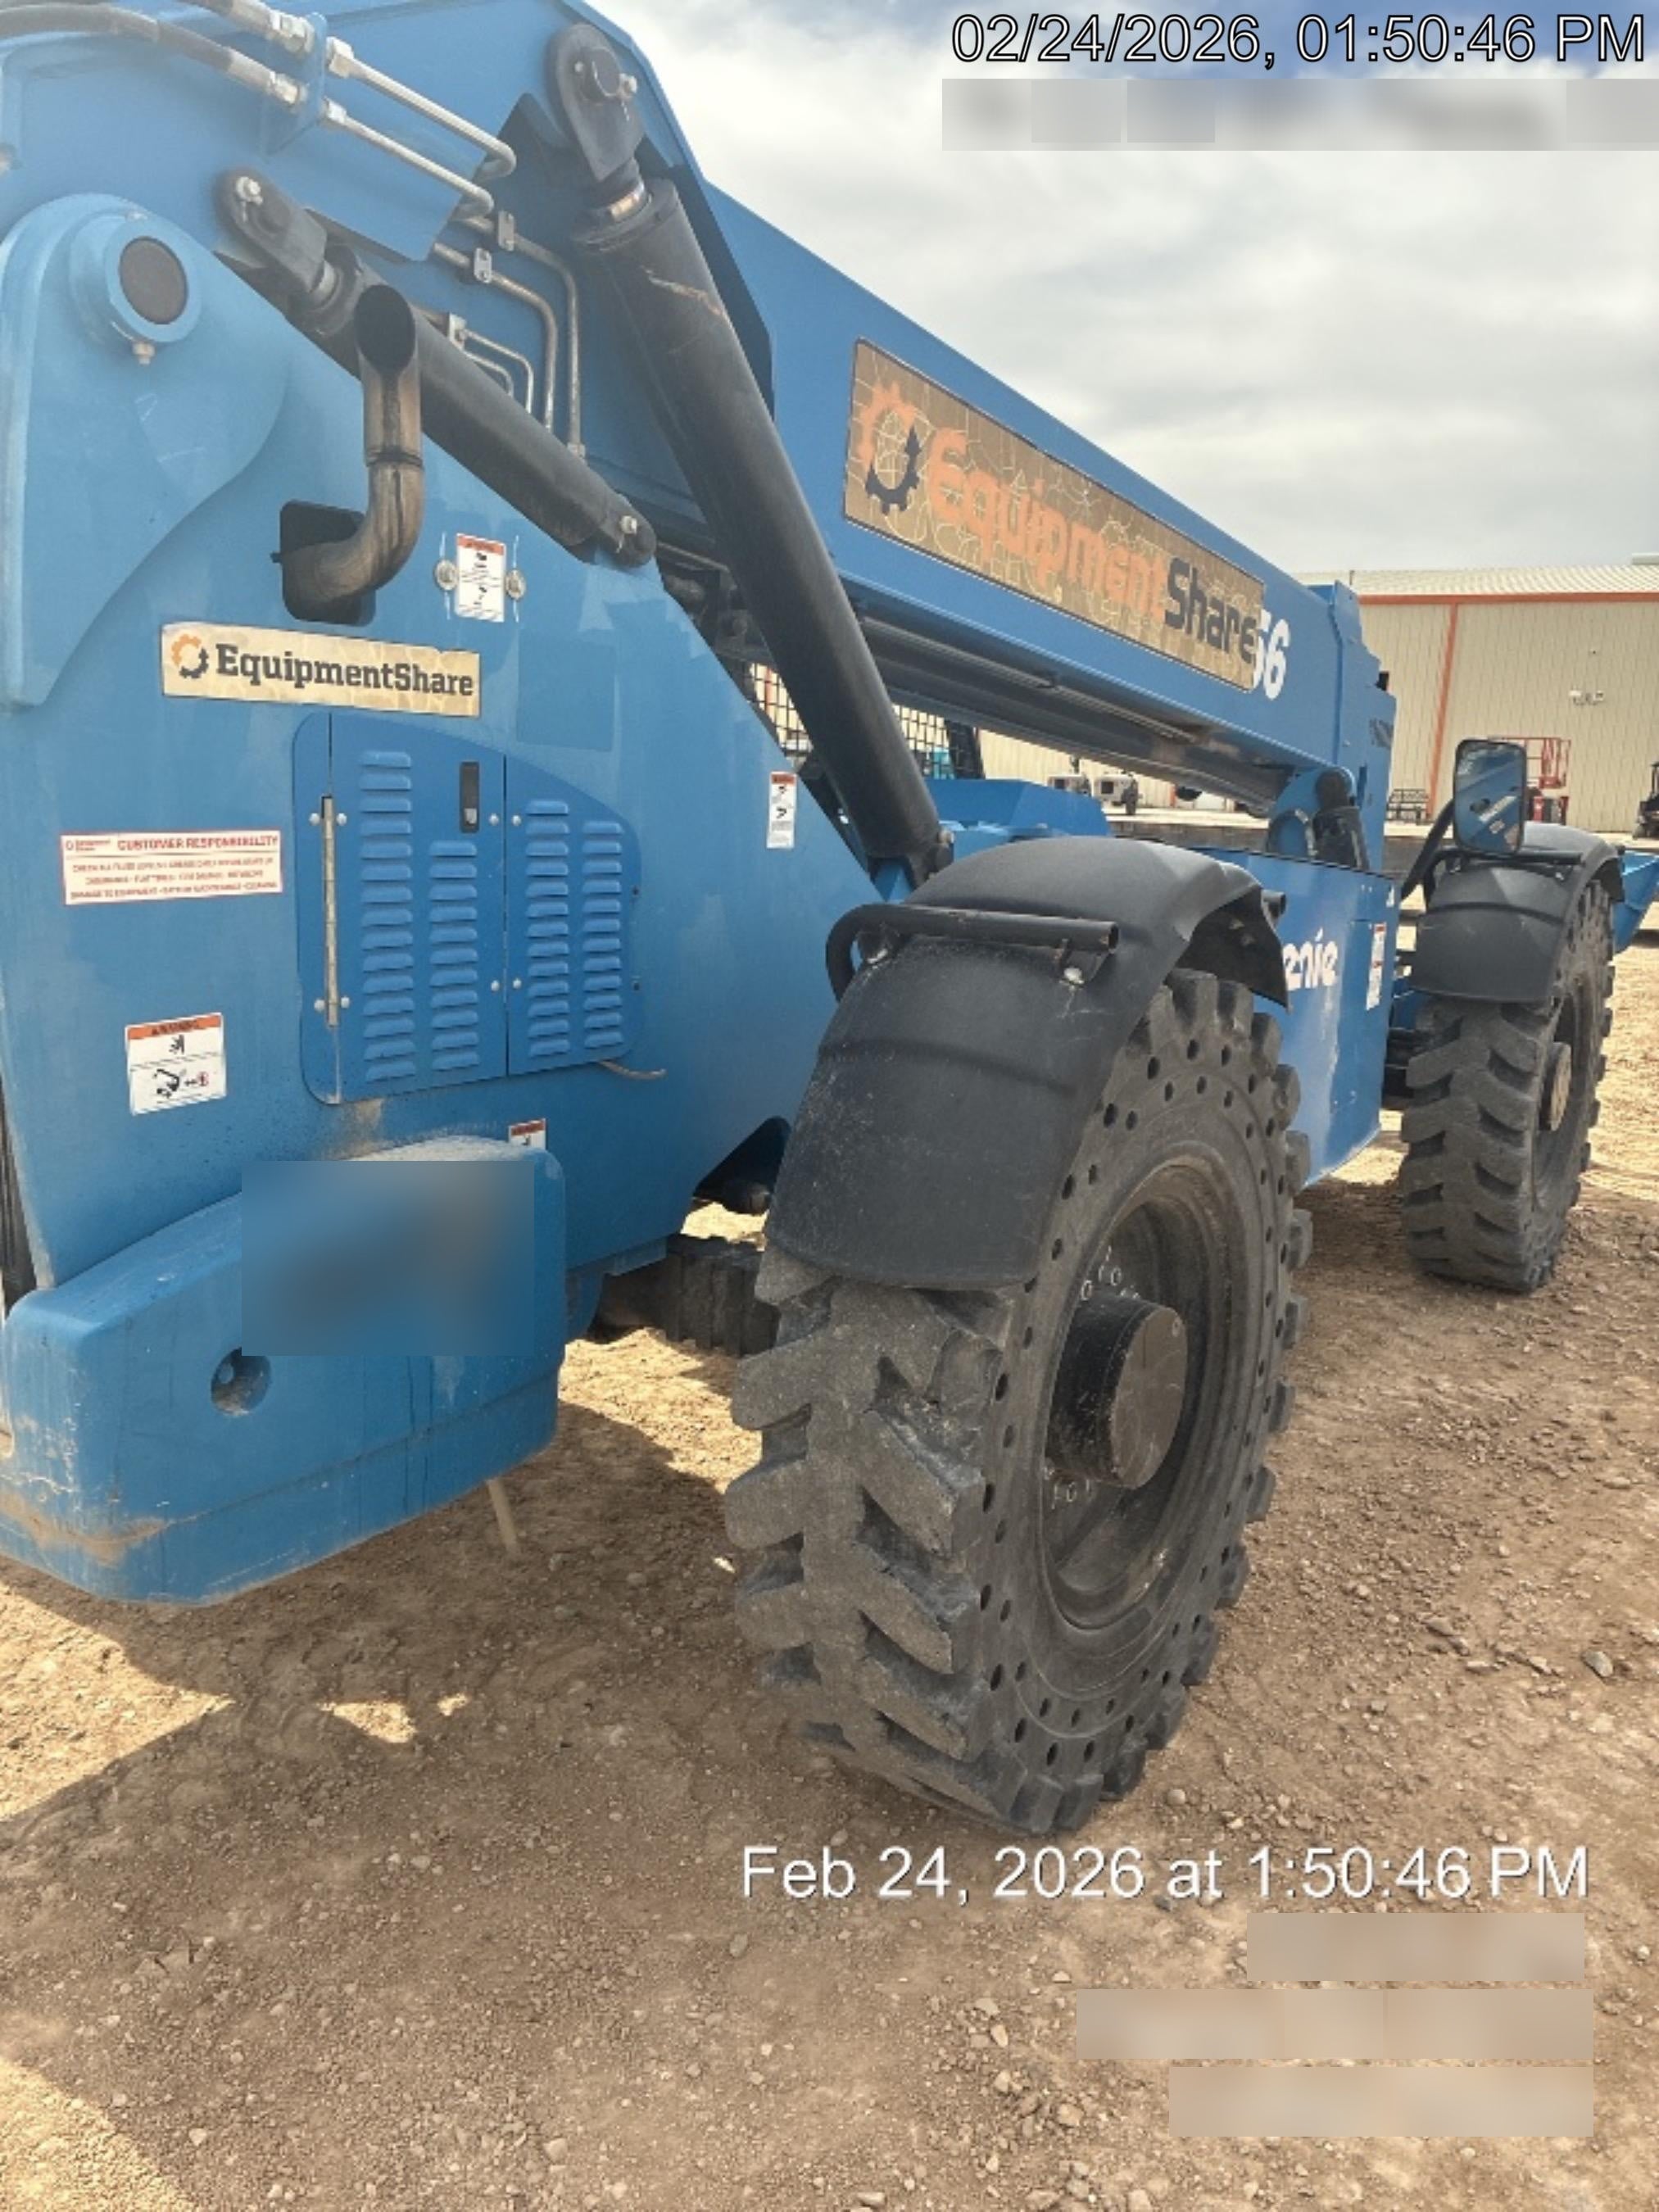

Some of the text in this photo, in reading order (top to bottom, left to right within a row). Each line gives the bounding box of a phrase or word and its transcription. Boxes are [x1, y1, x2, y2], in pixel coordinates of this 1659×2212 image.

[927, 426, 1257, 664] EquipmentShare
[215, 642, 474, 696] EquipmentShare
[1282, 927, 1339, 992] enie
